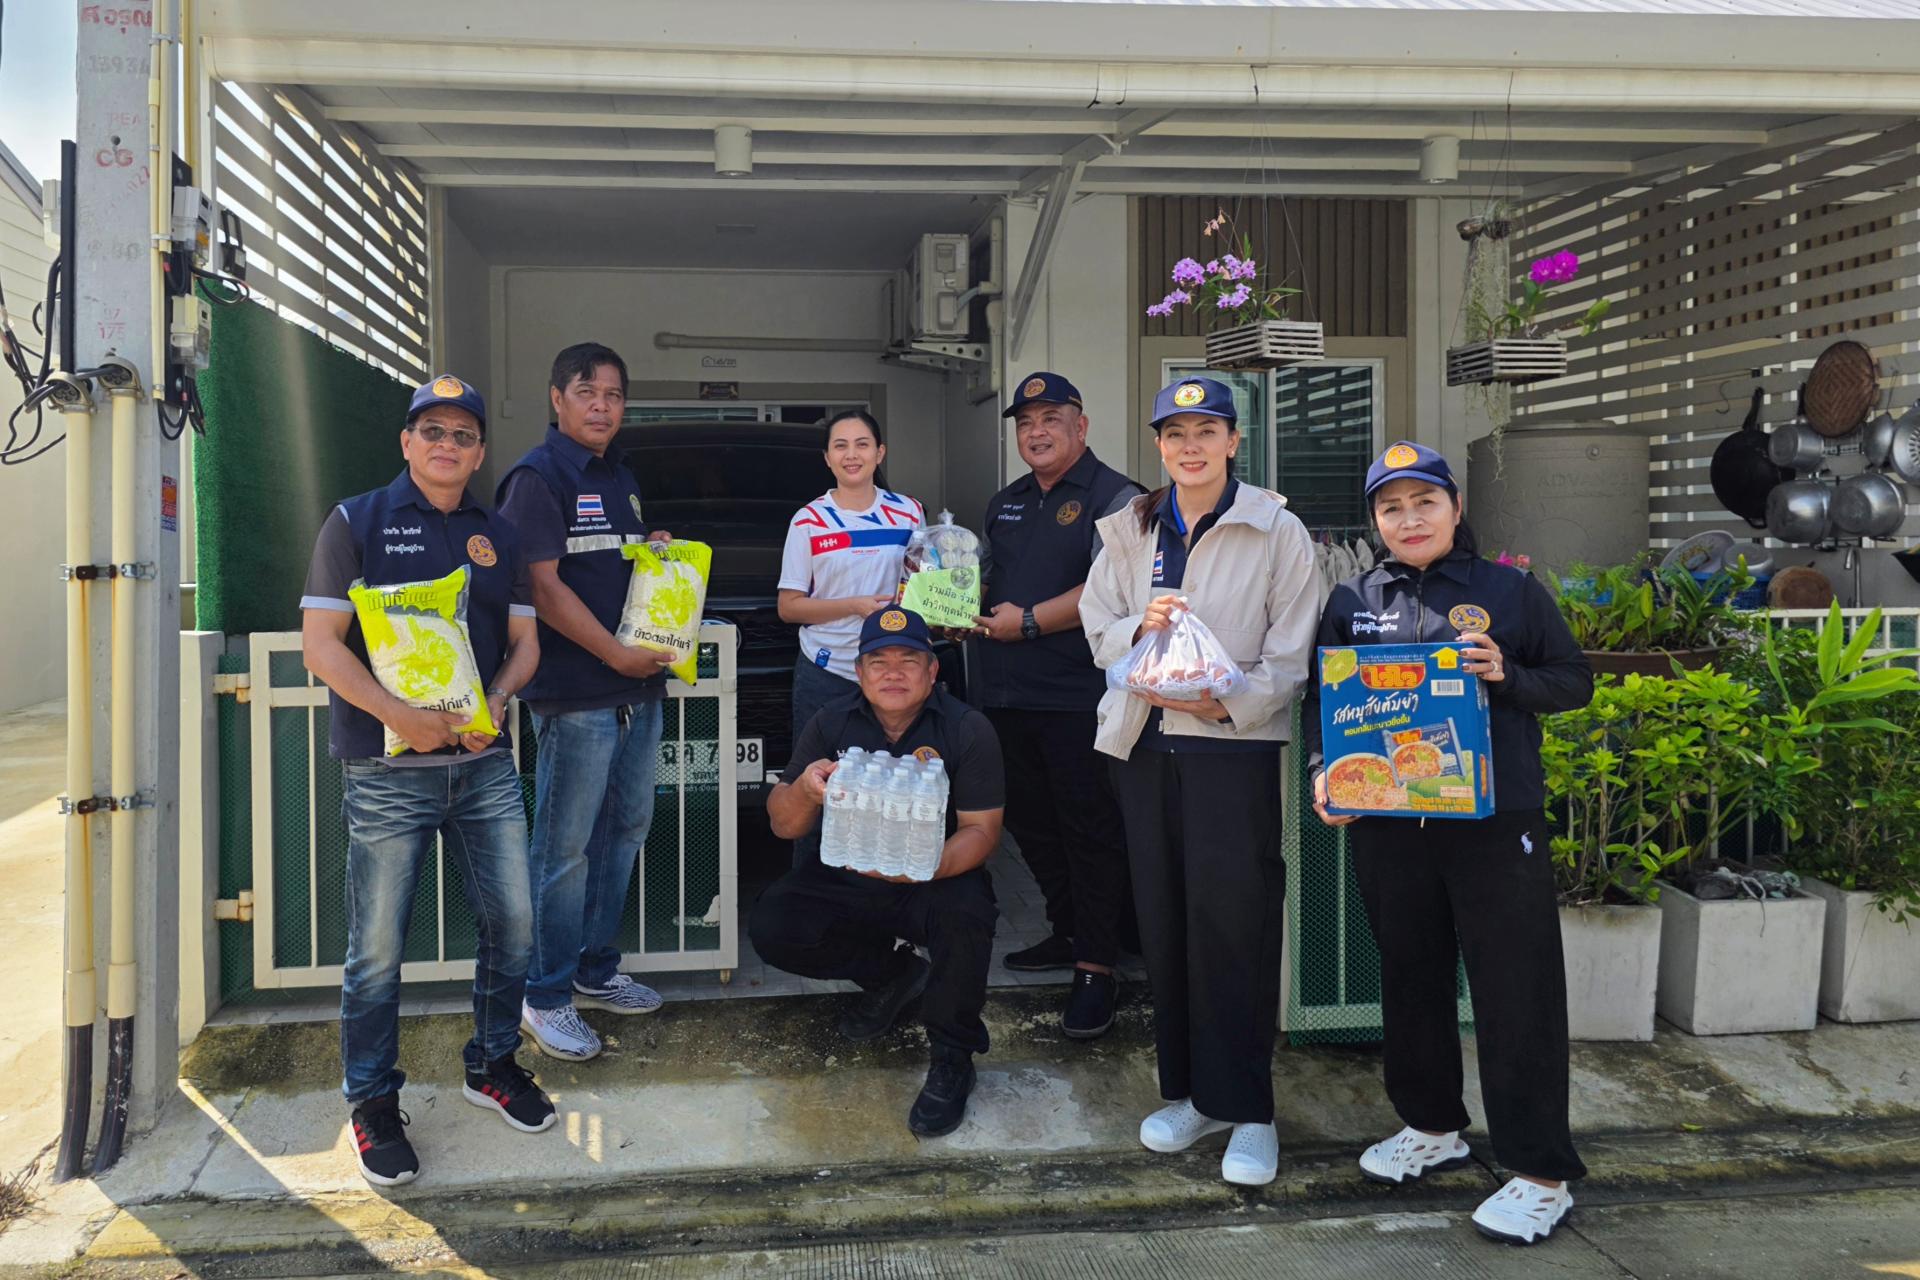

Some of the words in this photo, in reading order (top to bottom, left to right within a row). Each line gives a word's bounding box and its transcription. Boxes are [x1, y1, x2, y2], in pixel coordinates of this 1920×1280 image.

[634, 627, 691, 651] ข้าวตราไก่แจ้
